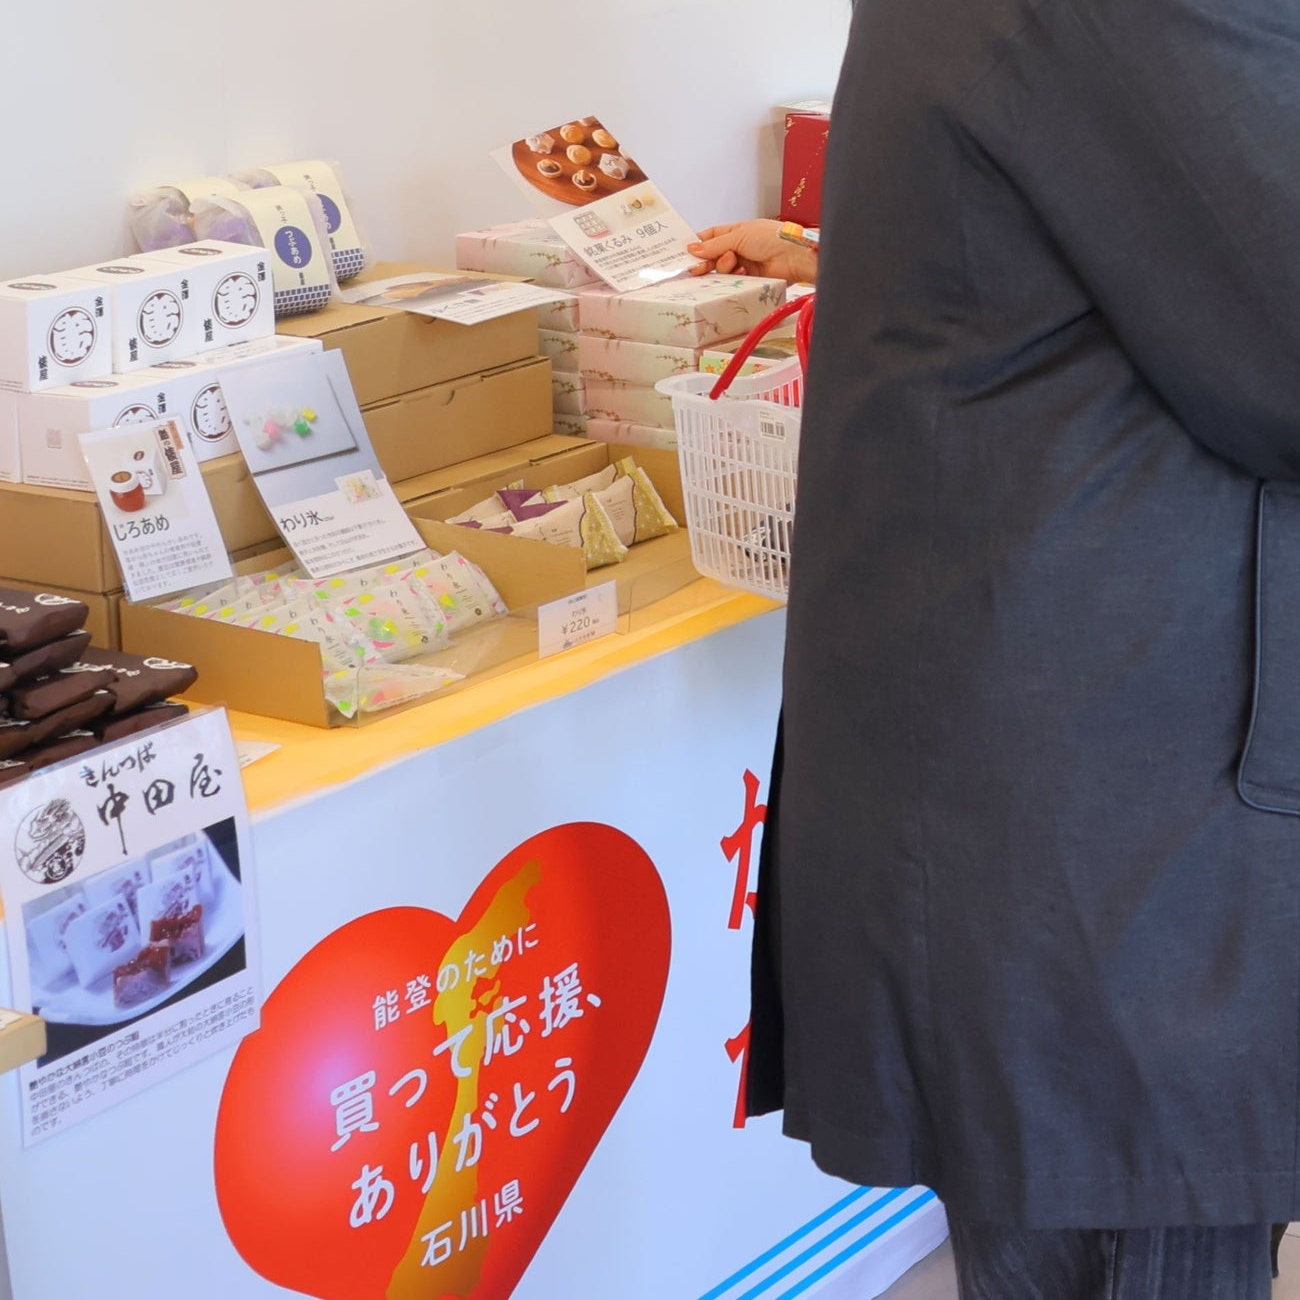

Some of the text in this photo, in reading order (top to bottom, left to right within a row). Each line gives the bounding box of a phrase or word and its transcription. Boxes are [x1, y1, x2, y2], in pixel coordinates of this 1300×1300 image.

[635, 219, 669, 239] 9個入
[112, 513, 170, 542] じろあめ
[279, 508, 325, 533] わり氷
[78, 740, 157, 788] きんつば
[96, 752, 223, 856] 中田屋
[371, 923, 540, 1031] 能登のために
[329, 962, 602, 1153] 買って応援、
[348, 1057, 577, 1229] ありがとう
[419, 1178, 525, 1268] 石川県
